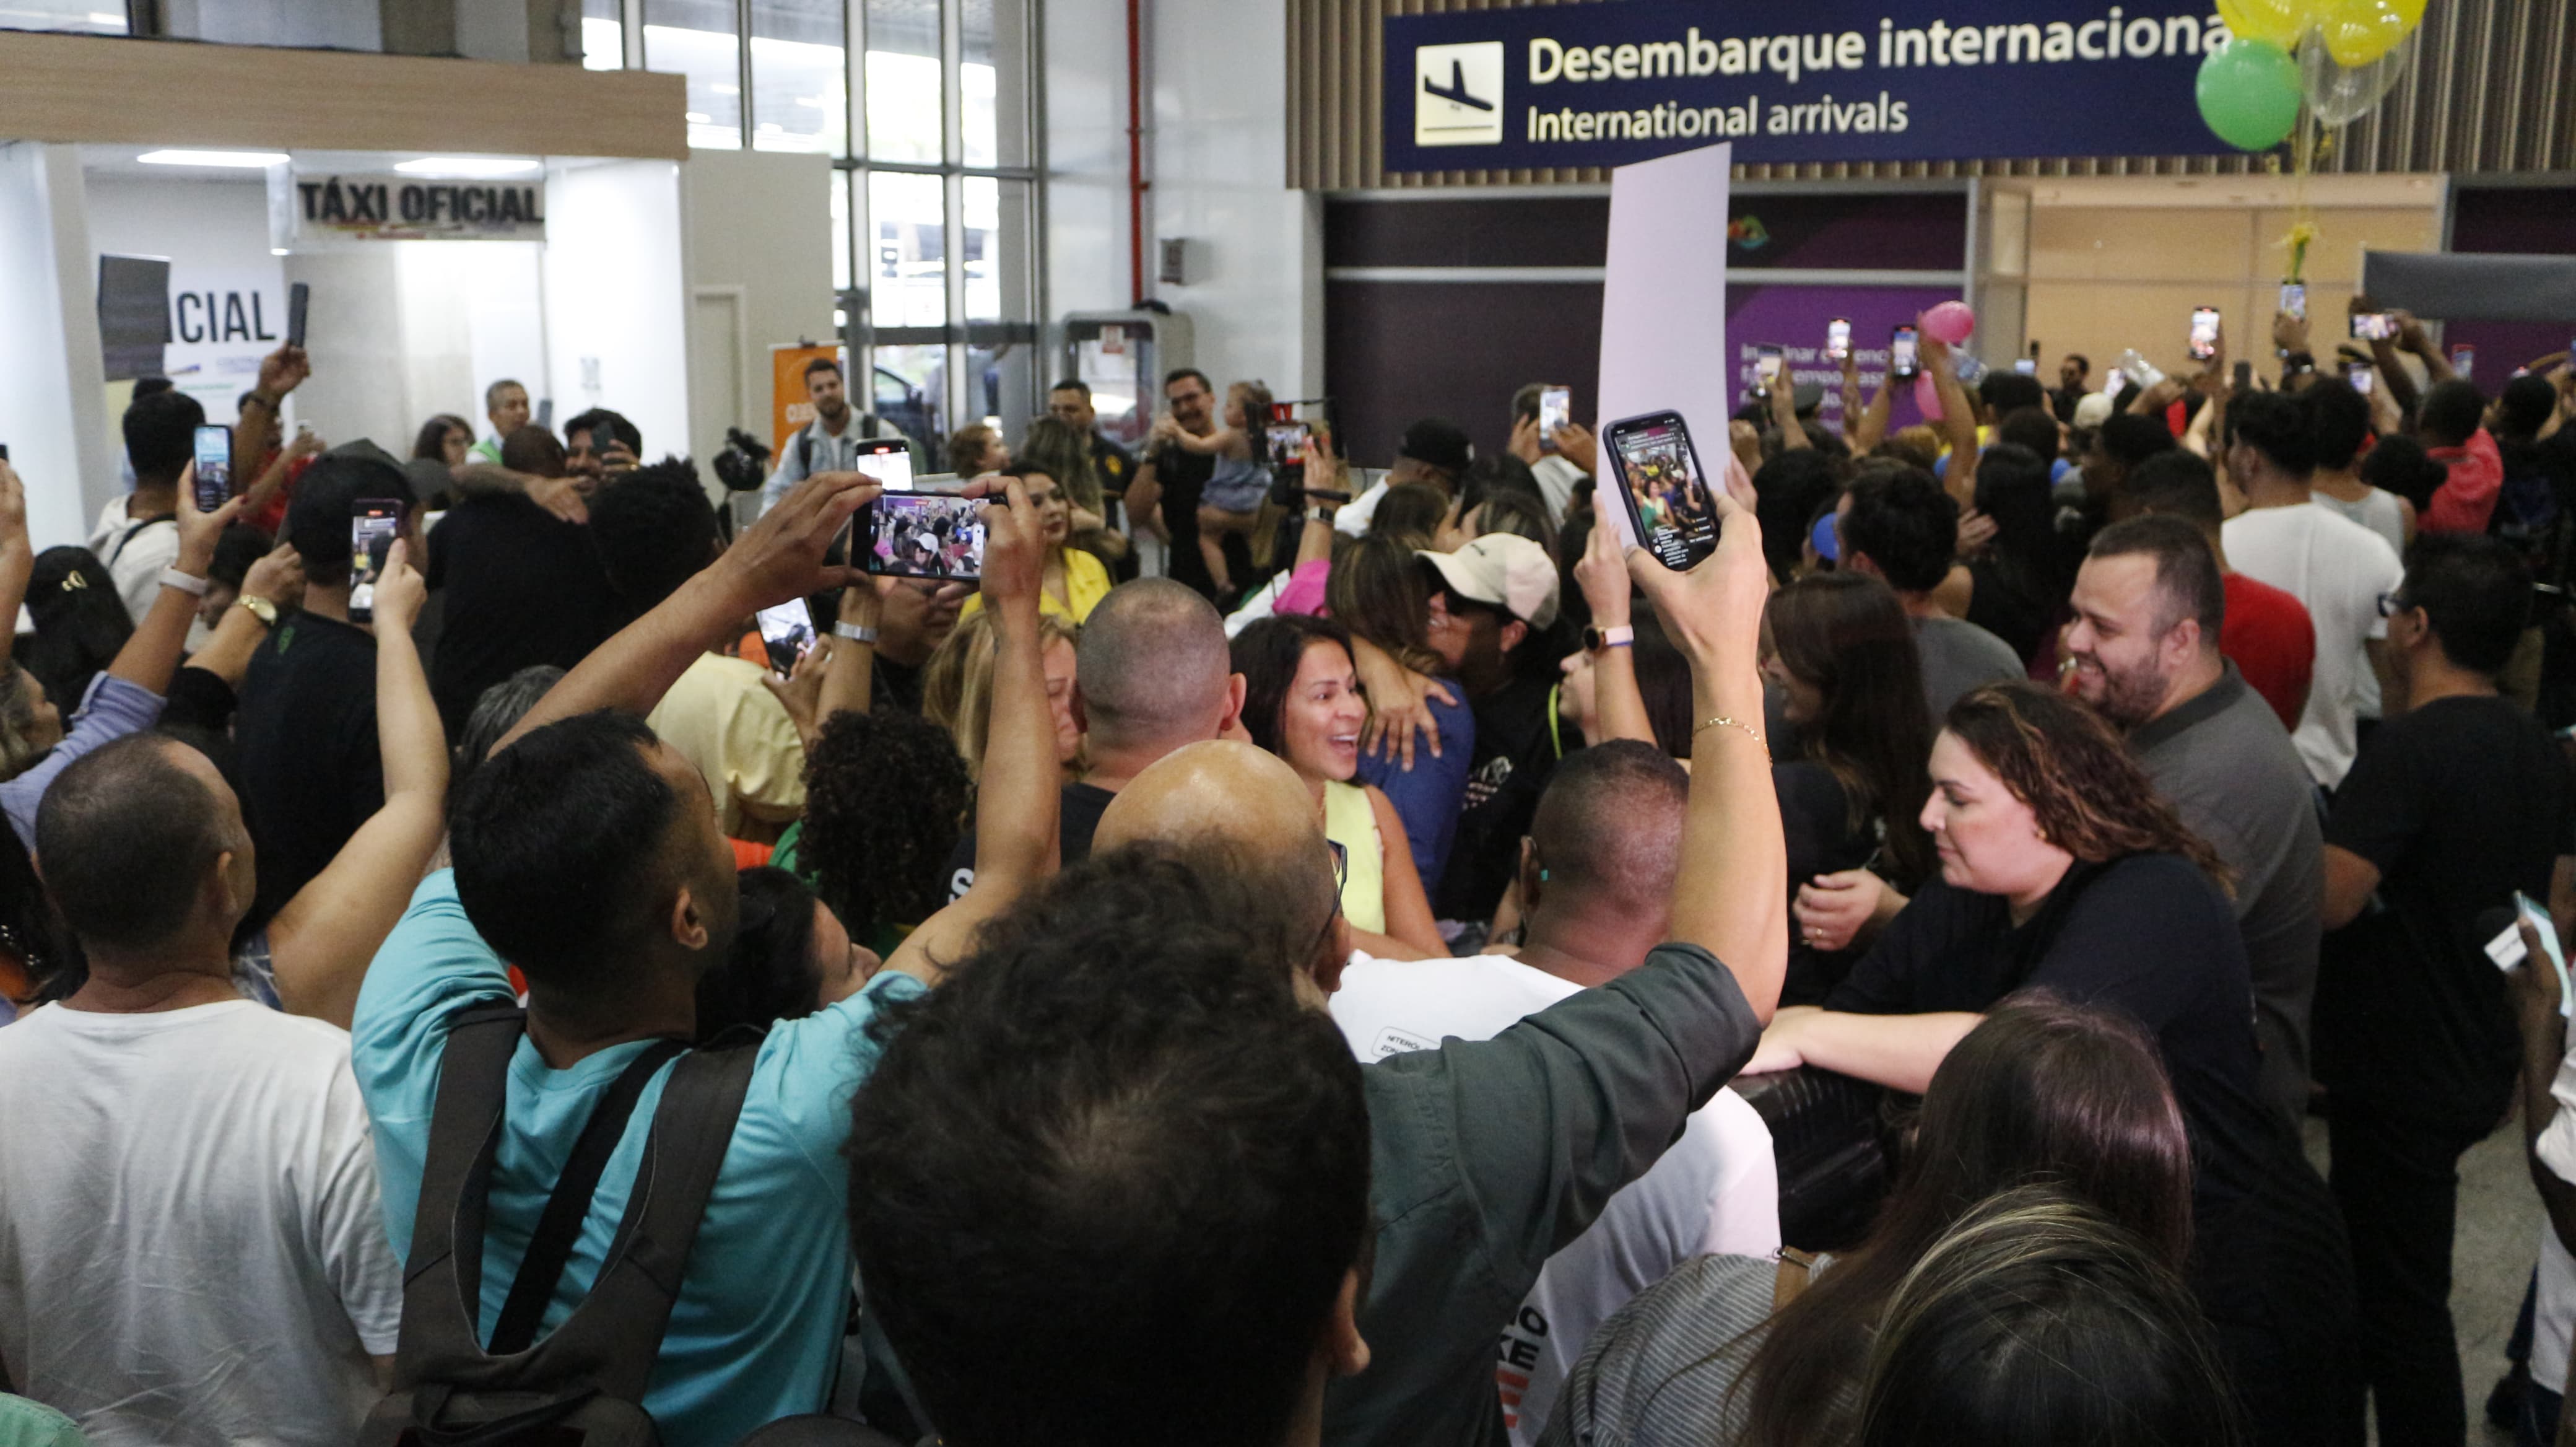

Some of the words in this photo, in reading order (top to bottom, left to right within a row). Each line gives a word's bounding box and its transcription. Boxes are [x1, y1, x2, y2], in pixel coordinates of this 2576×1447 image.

[1528, 27, 1866, 84] Desembarque
[1878, 6, 2234, 68] internaciona
[1527, 95, 1759, 143] International
[1766, 90, 1909, 136] arrivals
[297, 175, 388, 221] TÁXI
[399, 183, 545, 223] OFICIAL
[164, 291, 277, 343] ICIAL
